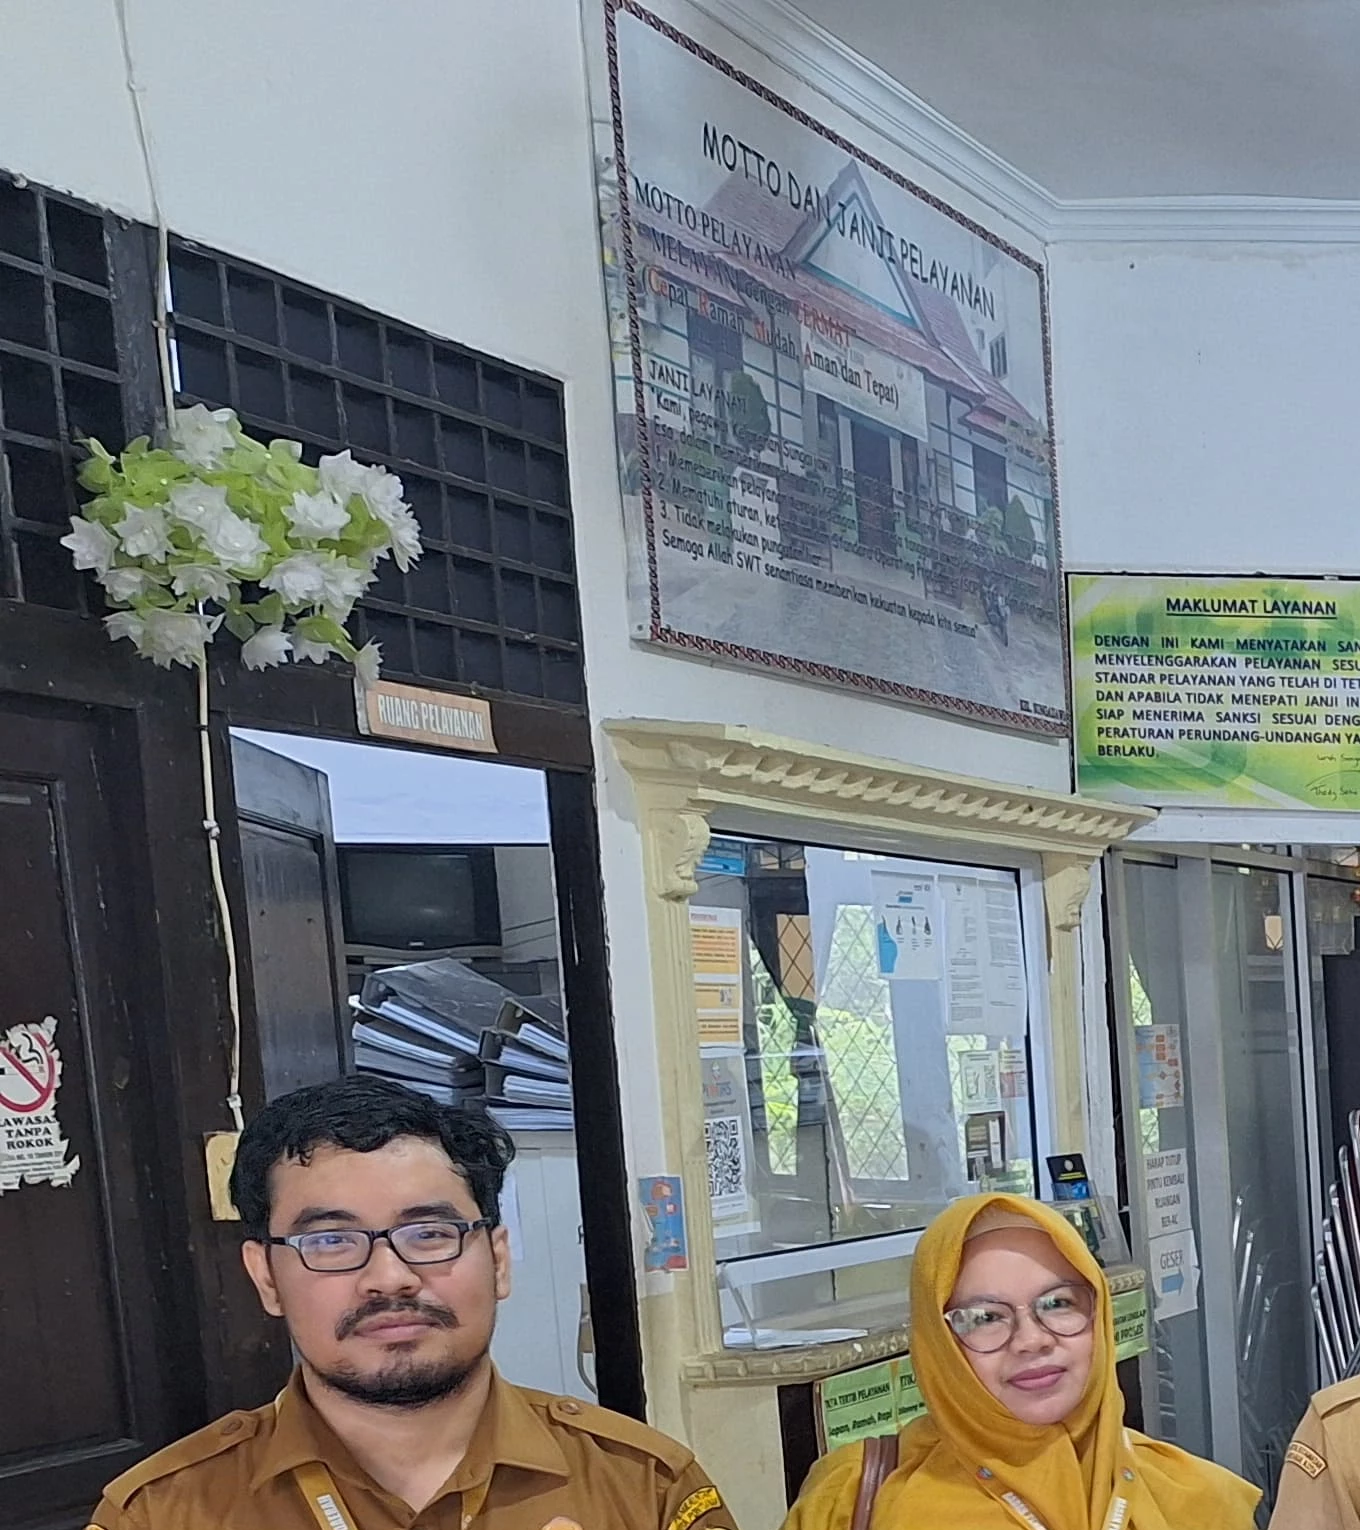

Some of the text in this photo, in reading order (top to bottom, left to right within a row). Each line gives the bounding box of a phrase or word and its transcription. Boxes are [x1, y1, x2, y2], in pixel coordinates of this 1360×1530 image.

[634, 175, 697, 232] MOTTO
[702, 215, 797, 280] PELAYANAN
[702, 122, 996, 321] MOTTO DAN JANJI PELAYANAN
[649, 360, 689, 392] JANJI
[805, 343, 899, 410] Aman Tepat)
[663, 529, 761, 574] Semoga Allah SWT
[1166, 597, 1337, 615] MAKLUMAT LAYANAN
[1094, 635, 1149, 649] DENGAN
[1161, 636, 1179, 649] INI
[1190, 637, 1225, 650] KAMI
[1236, 638, 1326, 652] MENYATAKAN
[1095, 654, 1237, 669] MENYELENGGARAKAN
[1244, 656, 1321, 671] PELAYANAN
[1095, 672, 1155, 684] STANDAR
[1159, 673, 1236, 687] PELAYANAN
[1238, 675, 1276, 688] YANG
[1279, 675, 1320, 689] TELAH
[1323, 677, 1338, 689] DI
[1096, 690, 1124, 702] DAN
[1128, 691, 1182, 704] APABILA
[1185, 693, 1223, 705] TIDAK
[1231, 694, 1298, 707] MENEPATI
[1304, 695, 1338, 708] JANJI
[377, 694, 485, 741] RUANG PELAYANAN
[1096, 708, 1124, 721] SIAP
[1132, 709, 1205, 723] MENERIMA
[1216, 711, 1261, 724] SANKSI
[1271, 712, 1316, 726] SESUAI
[1097, 726, 1174, 740] PERATURAN
[1178, 728, 1341, 744] PERUNDANG-UNDANGAN
[1098, 744, 1159, 758] BERLAKU.
[6, 1127, 52, 1139] TANPA
[7, 1138, 54, 1150] ROKOK
